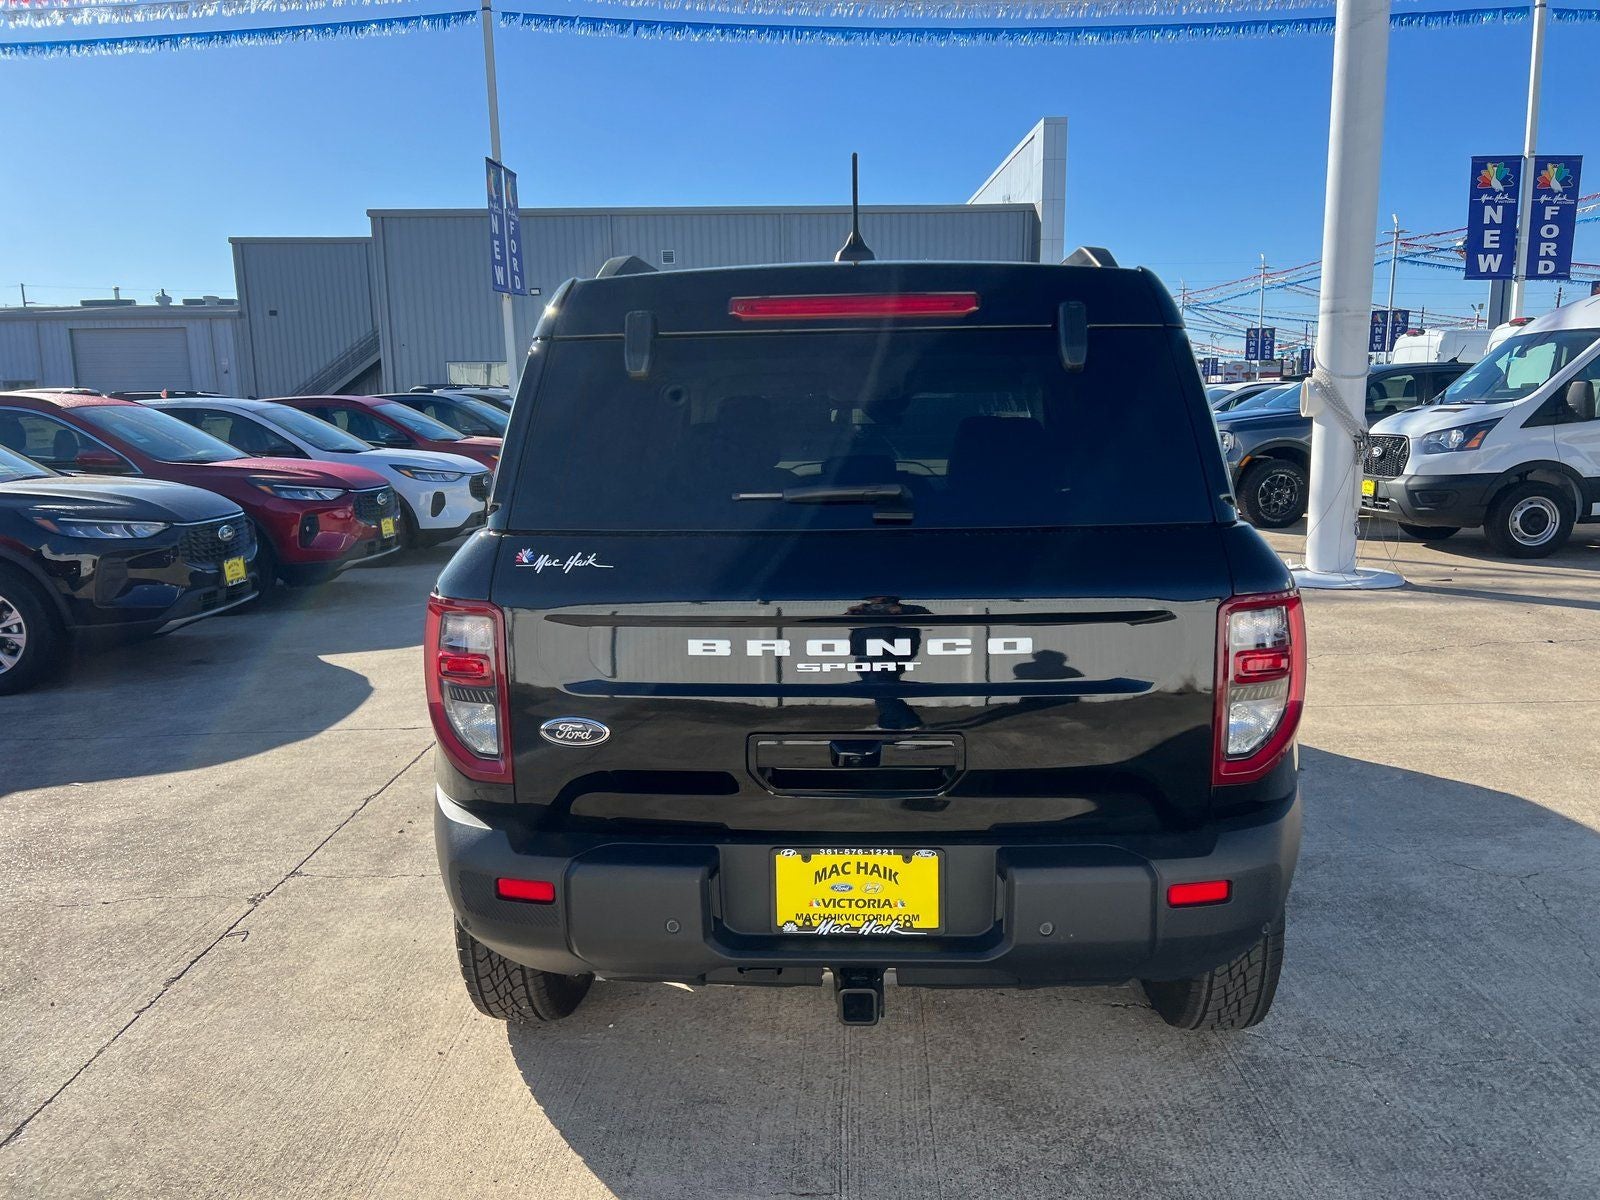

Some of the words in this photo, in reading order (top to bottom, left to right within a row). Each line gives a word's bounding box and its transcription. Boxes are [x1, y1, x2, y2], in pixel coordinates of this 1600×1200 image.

[492, 213, 505, 286] NEW
[1478, 205, 1503, 273] NEW
[1537, 205, 1560, 275] FORD
[510, 221, 521, 290] FORD
[1248, 340, 1256, 359] NEW
[1373, 327, 1383, 351] NEW
[526, 554, 563, 574] Mac
[562, 552, 608, 574] Haik
[688, 637, 1033, 657] BRONCO
[797, 661, 922, 672] SPORT
[819, 848, 895, 856] 361-576-1221
[814, 861, 852, 885] MAC
[856, 861, 899, 886] HAIK
[821, 898, 893, 909] VICTORIA
[795, 913, 920, 922] MACHAIKVICTORIACOM
[807, 918, 858, 935] Mac
[858, 919, 914, 936] Haik
